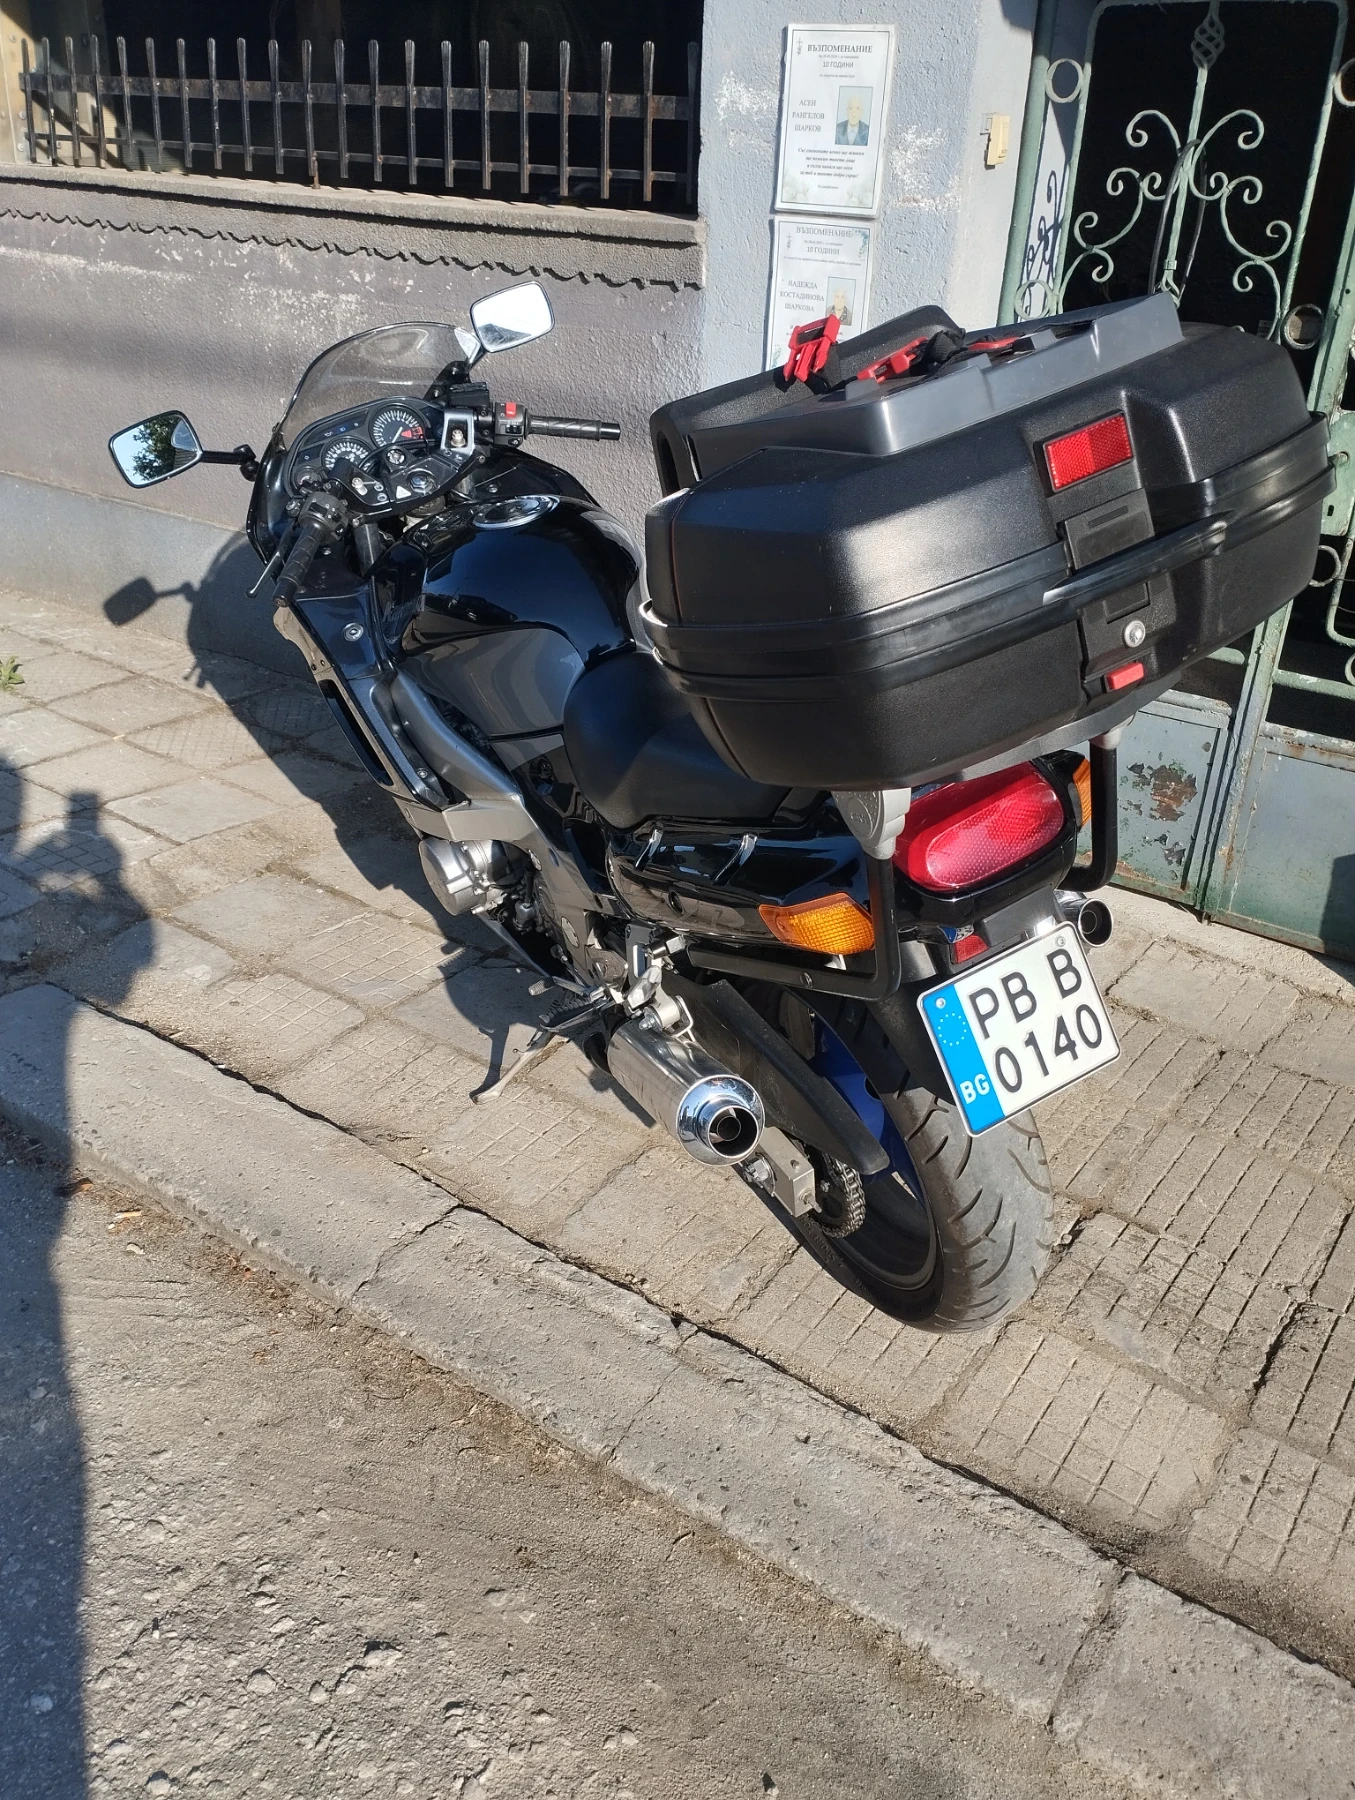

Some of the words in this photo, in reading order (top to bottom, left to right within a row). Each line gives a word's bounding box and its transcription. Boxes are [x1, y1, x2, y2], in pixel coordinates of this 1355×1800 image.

[807, 44, 873, 53] ВЪЗПОМЕНАНИЕ
[830, 61, 854, 69] ГОДИНИ
[799, 99, 817, 107] АСЕН
[792, 111, 825, 120] РАНГЕЛОВ
[794, 124, 822, 132] ШАРКОВ
[796, 226, 854, 238] ВЪЗПОМЕНАНИЕ
[814, 246, 840, 255] ГОДИНИ
[788, 280, 818, 290] НАДЕЖДА
[780, 290, 825, 302] КОСТАДИНОВА
[784, 302, 815, 312] ШАРКОВА
[968, 971, 1037, 1040] PB
[1046, 948, 1082, 1000] B
[994, 1003, 1103, 1094] 0140
[959, 1073, 990, 1104] BG
